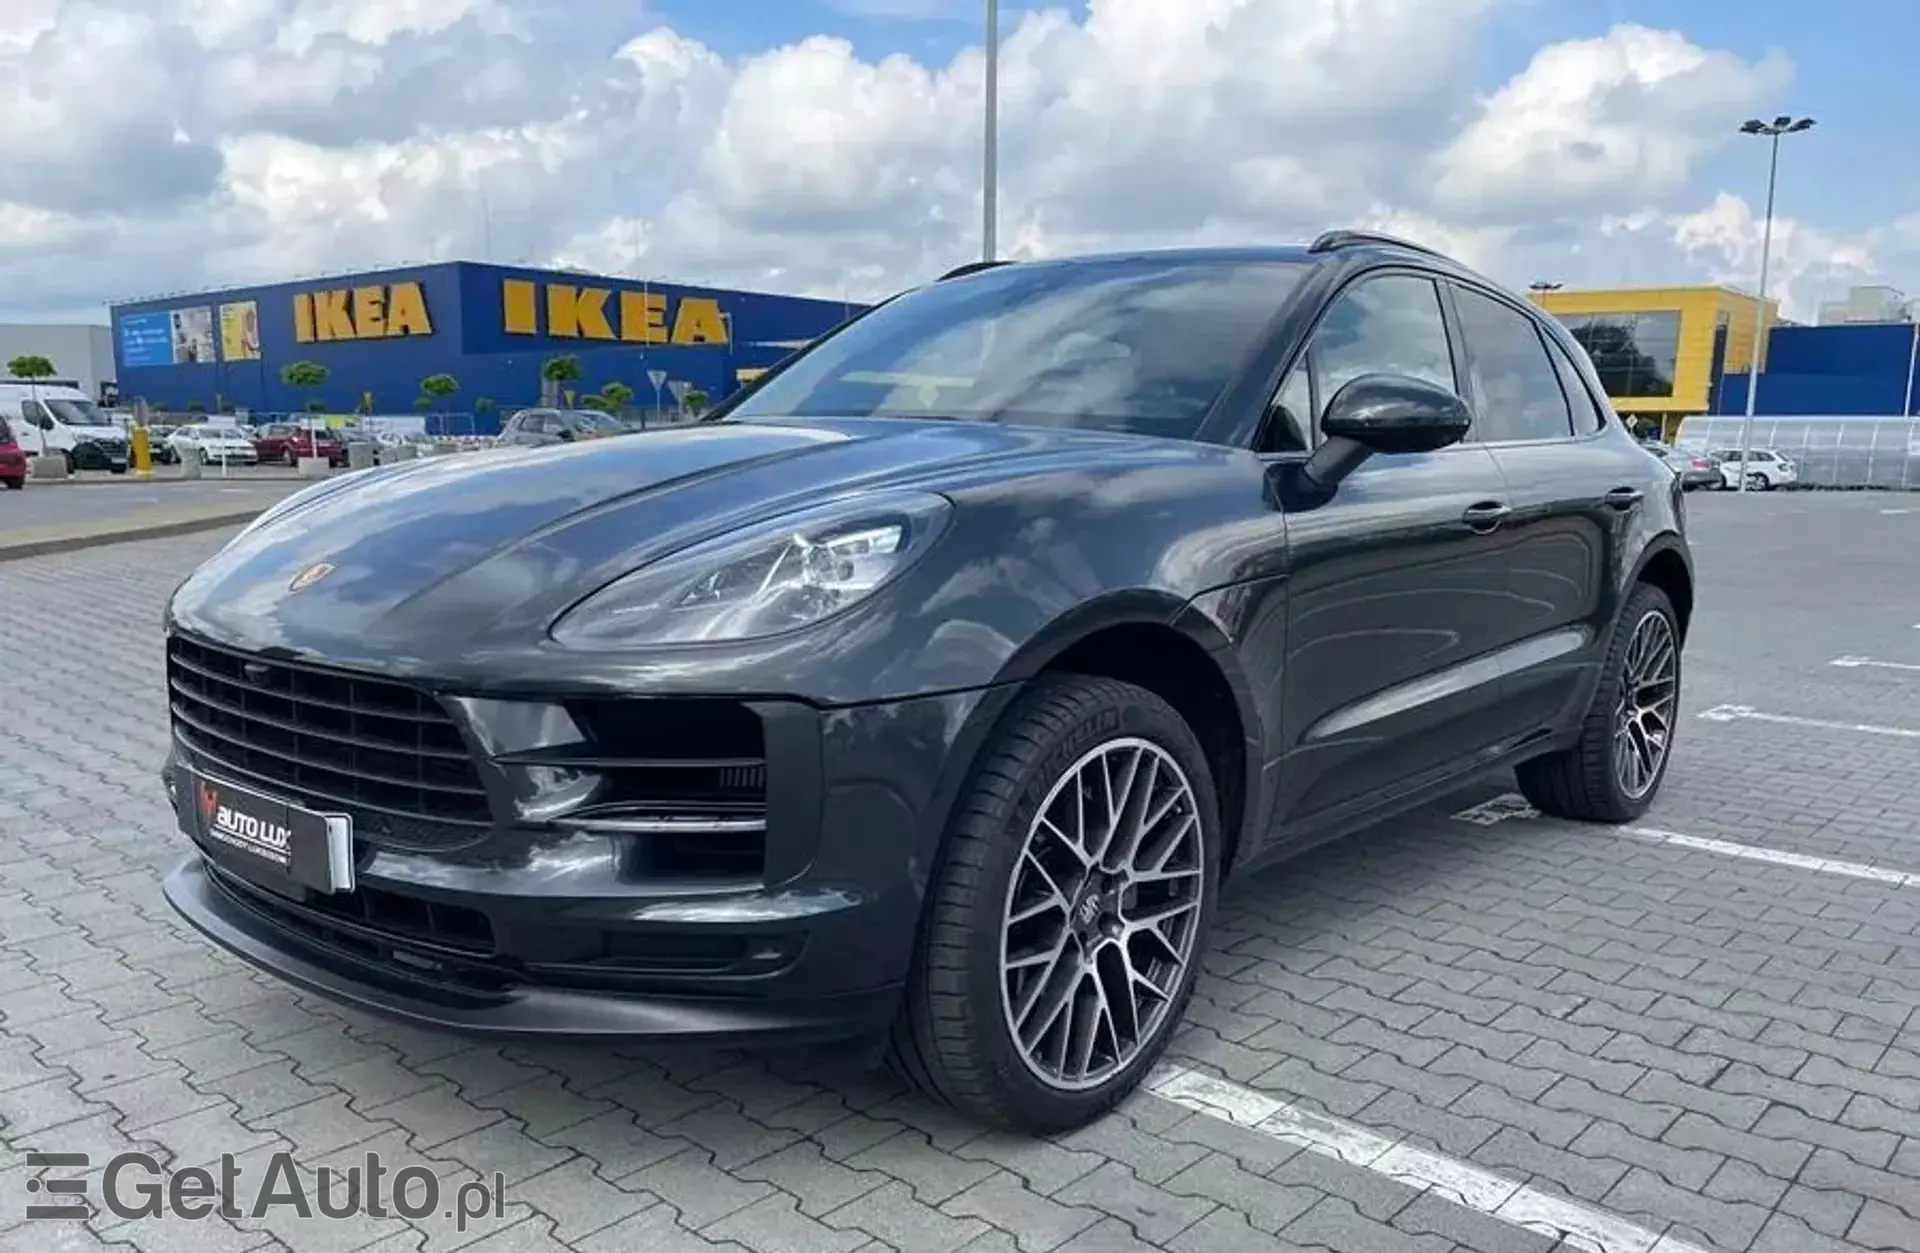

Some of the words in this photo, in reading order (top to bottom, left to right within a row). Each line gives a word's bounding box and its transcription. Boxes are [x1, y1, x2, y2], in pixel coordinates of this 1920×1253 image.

[293, 281, 433, 343] IKEA
[504, 279, 729, 344] IKEA
[260, 820, 292, 847] LUX
